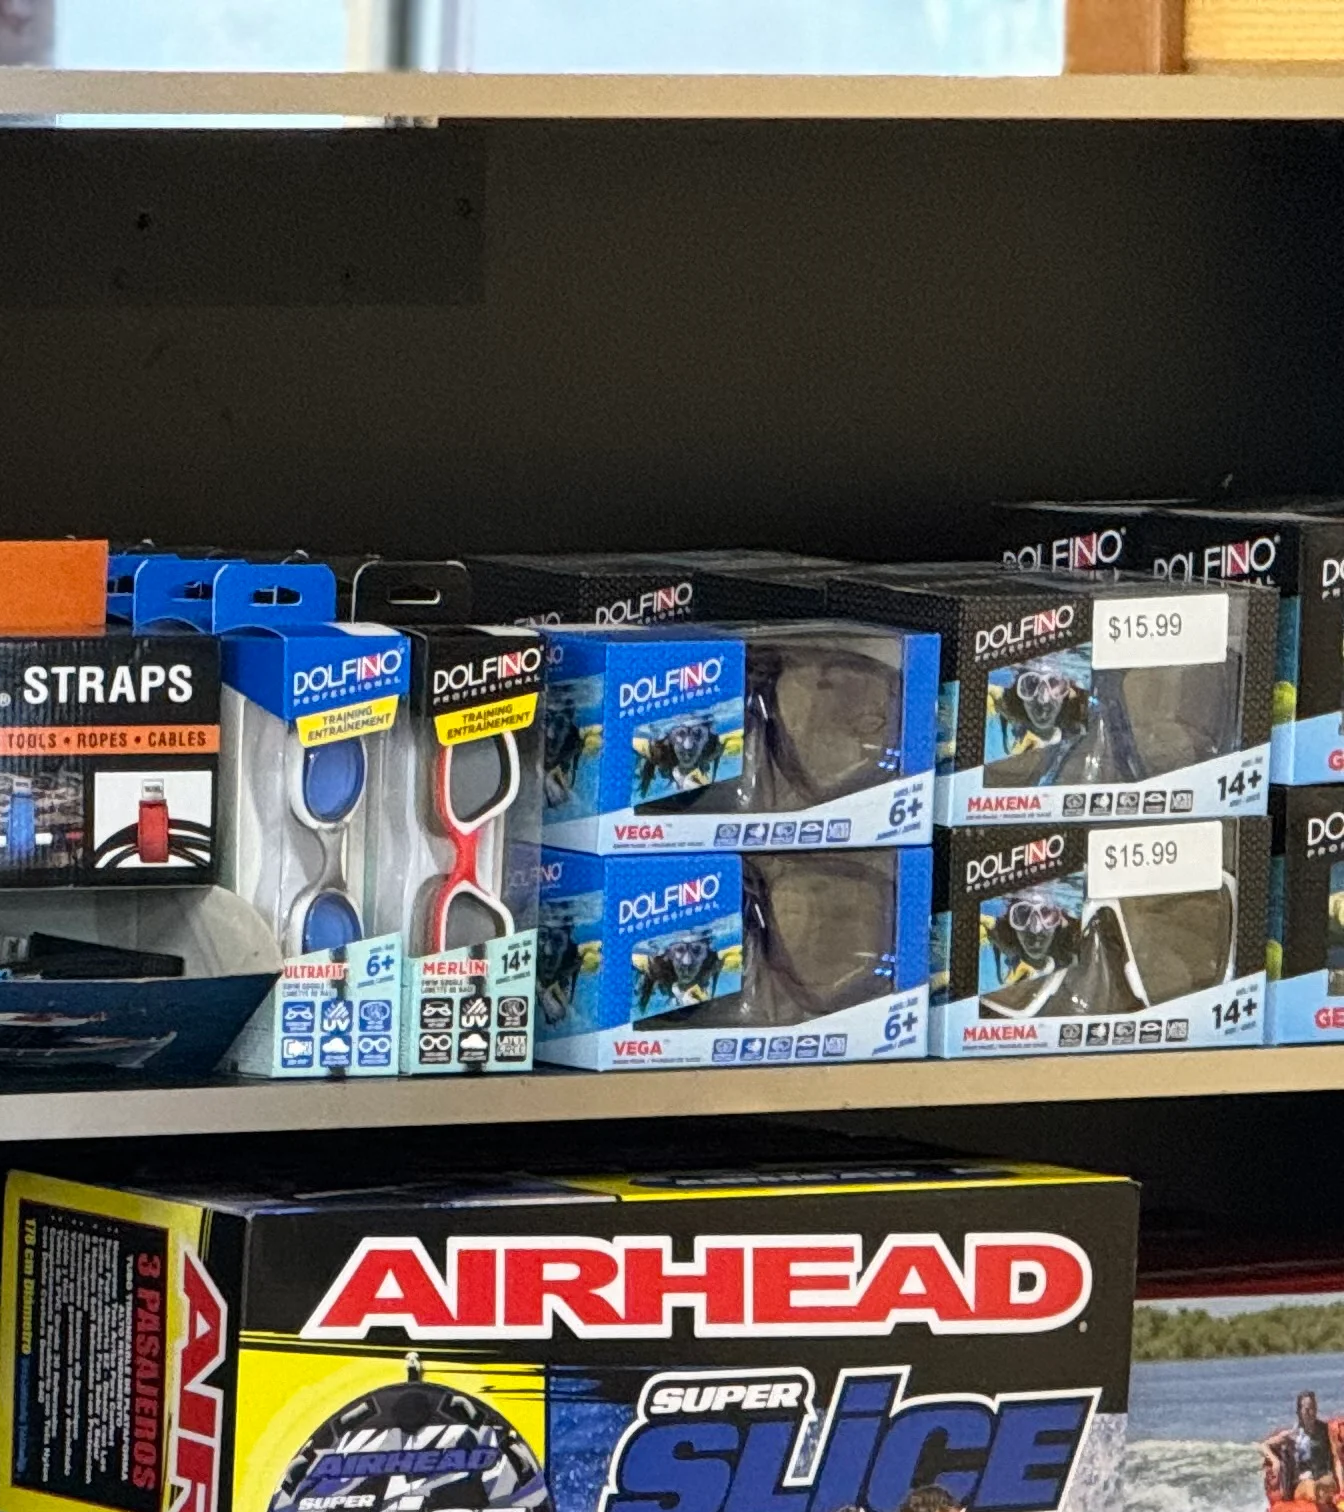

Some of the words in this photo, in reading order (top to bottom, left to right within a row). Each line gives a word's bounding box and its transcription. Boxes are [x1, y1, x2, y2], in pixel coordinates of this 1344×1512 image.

[975, 606, 1074, 654] DOLFINO
[1108, 612, 1183, 642] $15.99
[23, 665, 193, 704] STRAPS
[294, 648, 401, 696] DOLFINO
[434, 648, 541, 695] DOLFINO
[619, 658, 722, 709] DOLFINO
[294, 677, 401, 707] PROFESSIONAL
[322, 706, 373, 726] TRAINING
[7, 733, 57, 750] TOOLS
[76, 732, 128, 749] ROPES
[147, 731, 206, 748] CABLES
[1217, 769, 1262, 802] 14+
[888, 796, 924, 827] 6+
[967, 795, 1042, 812] MAKENA
[614, 825, 664, 841] VEGA
[967, 835, 1065, 885] DOLFINO
[1104, 840, 1178, 870] $15.99
[619, 874, 720, 926] DOLFINO
[284, 962, 347, 980] ULTRAFIT
[423, 960, 485, 976] MERLIN
[885, 1009, 918, 1043] 6+
[1212, 998, 1258, 1030] 14+
[614, 1041, 663, 1057] VEGA
[963, 1025, 1038, 1042] MAKENA
[136, 1253, 161, 1278] 3
[302, 1233, 1092, 1338] AIRHEAD
[131, 1288, 161, 1491] PASAJEROS
[650, 1382, 802, 1414] SUPER
